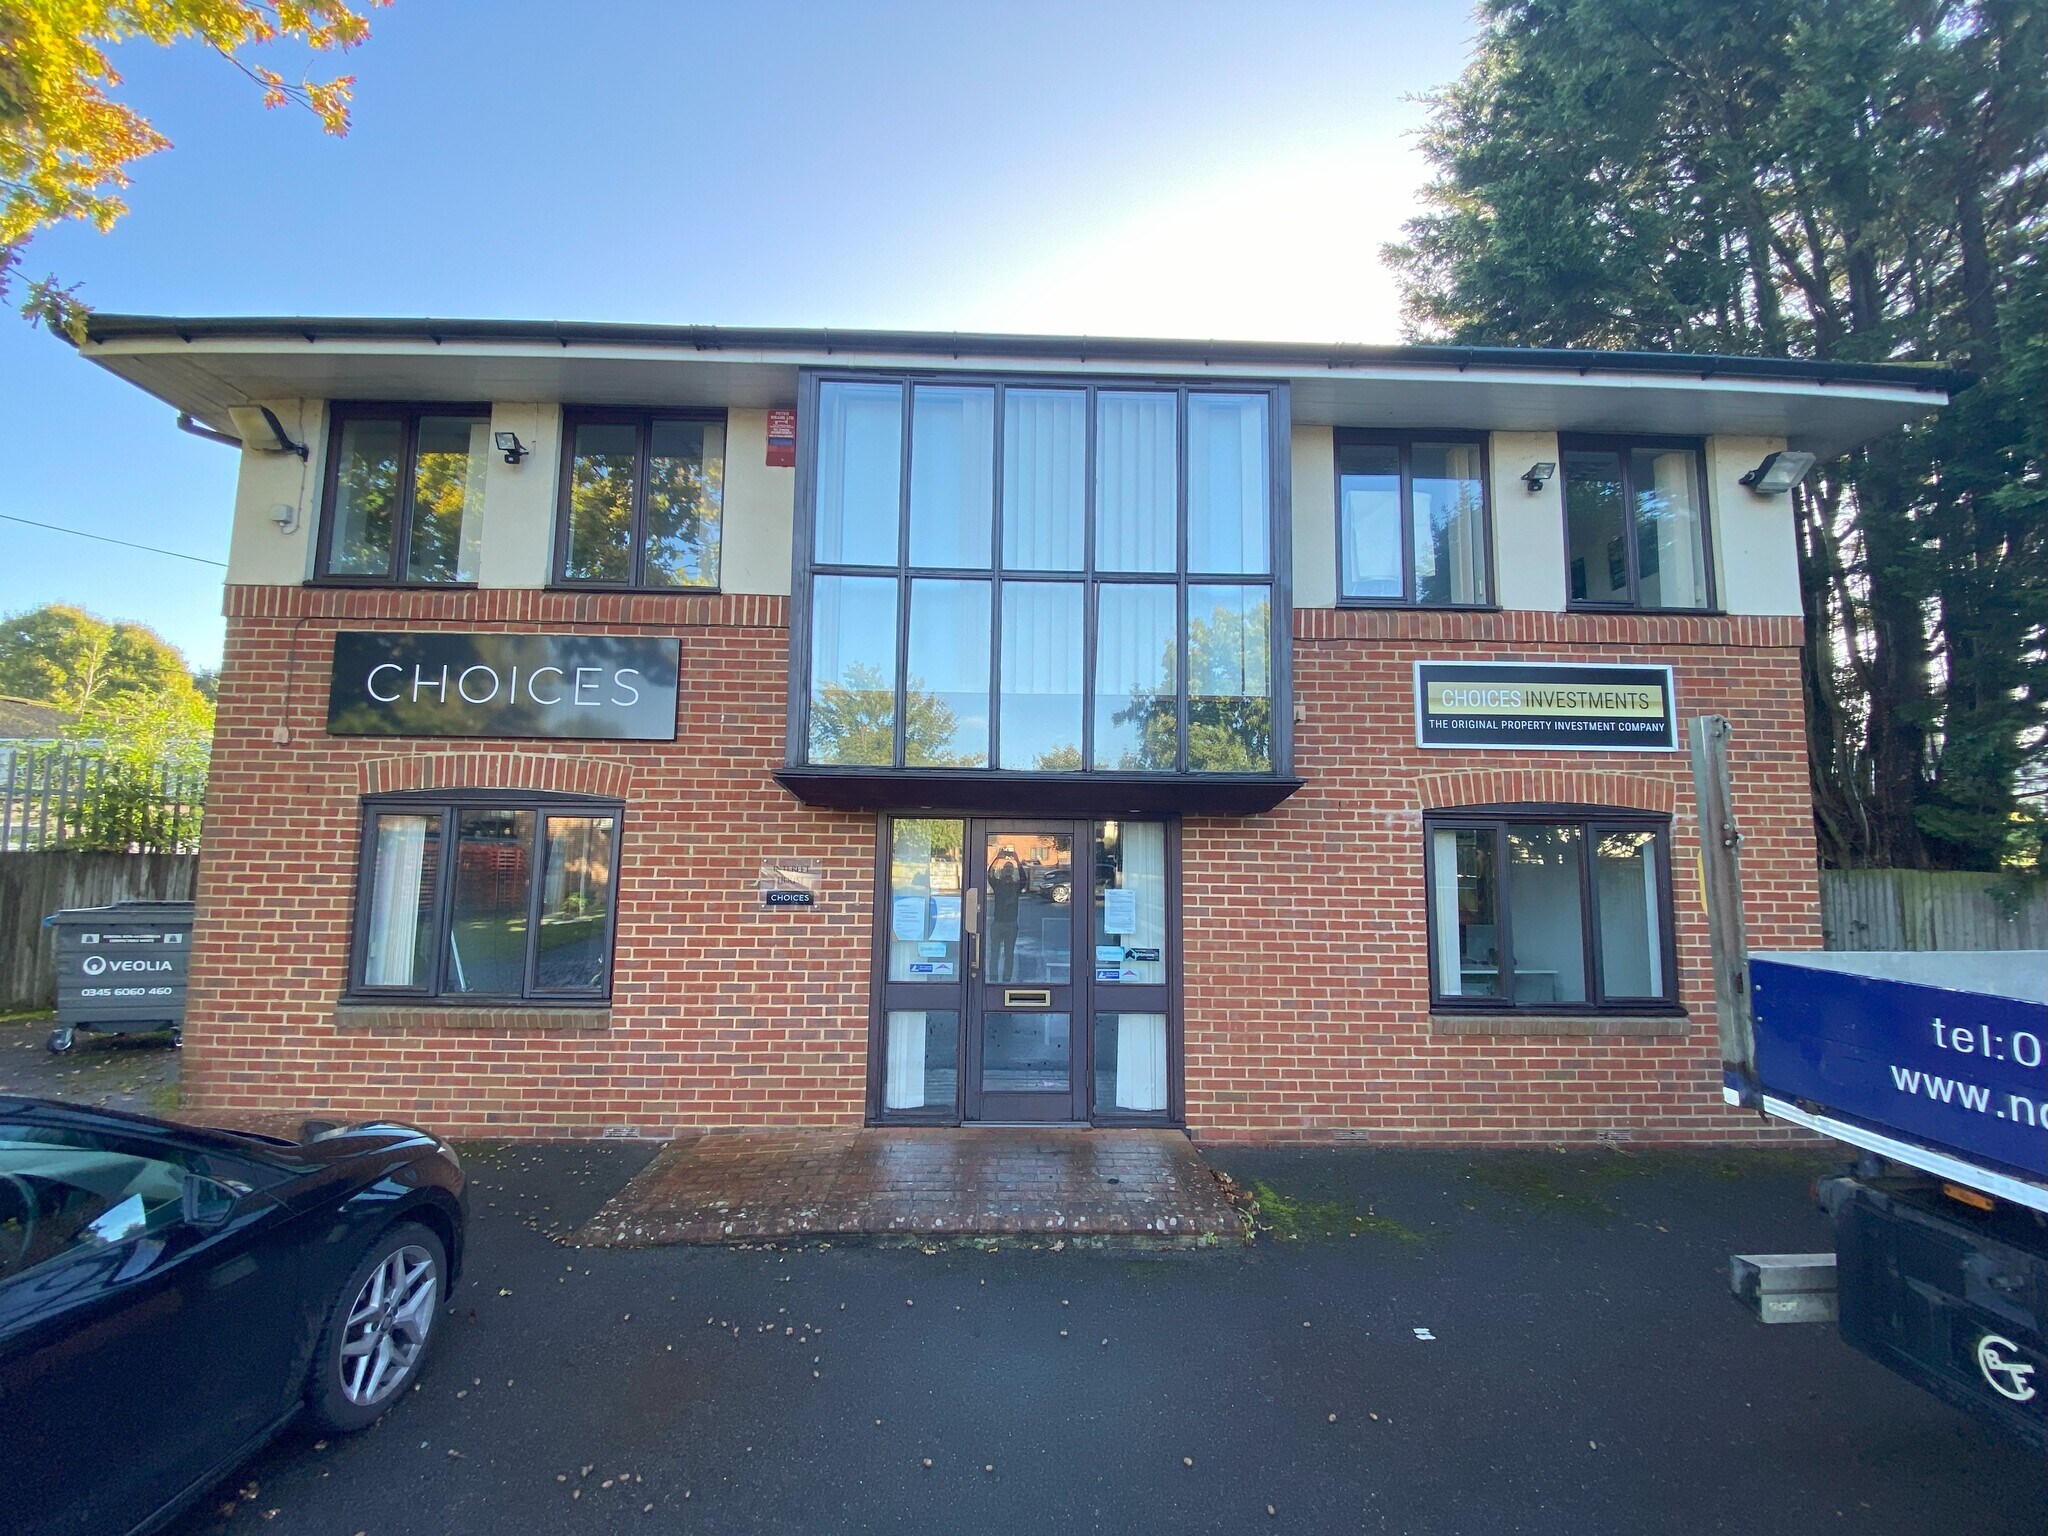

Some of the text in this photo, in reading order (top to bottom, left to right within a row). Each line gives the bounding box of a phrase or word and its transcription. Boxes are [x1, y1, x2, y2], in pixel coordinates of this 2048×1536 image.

[367, 663, 640, 706] CHOICES
[1442, 689, 1650, 710] CHOICES INVESTMENTS
[1429, 719, 1665, 732] THE ORIGINAL PROPERTY INVESTMENT COMPANY
[770, 894, 810, 902] CHOICES
[109, 960, 173, 972] VEOLIA
[81, 987, 172, 997] 0345 6060 460
[1932, 1017, 2041, 1067] tel:0
